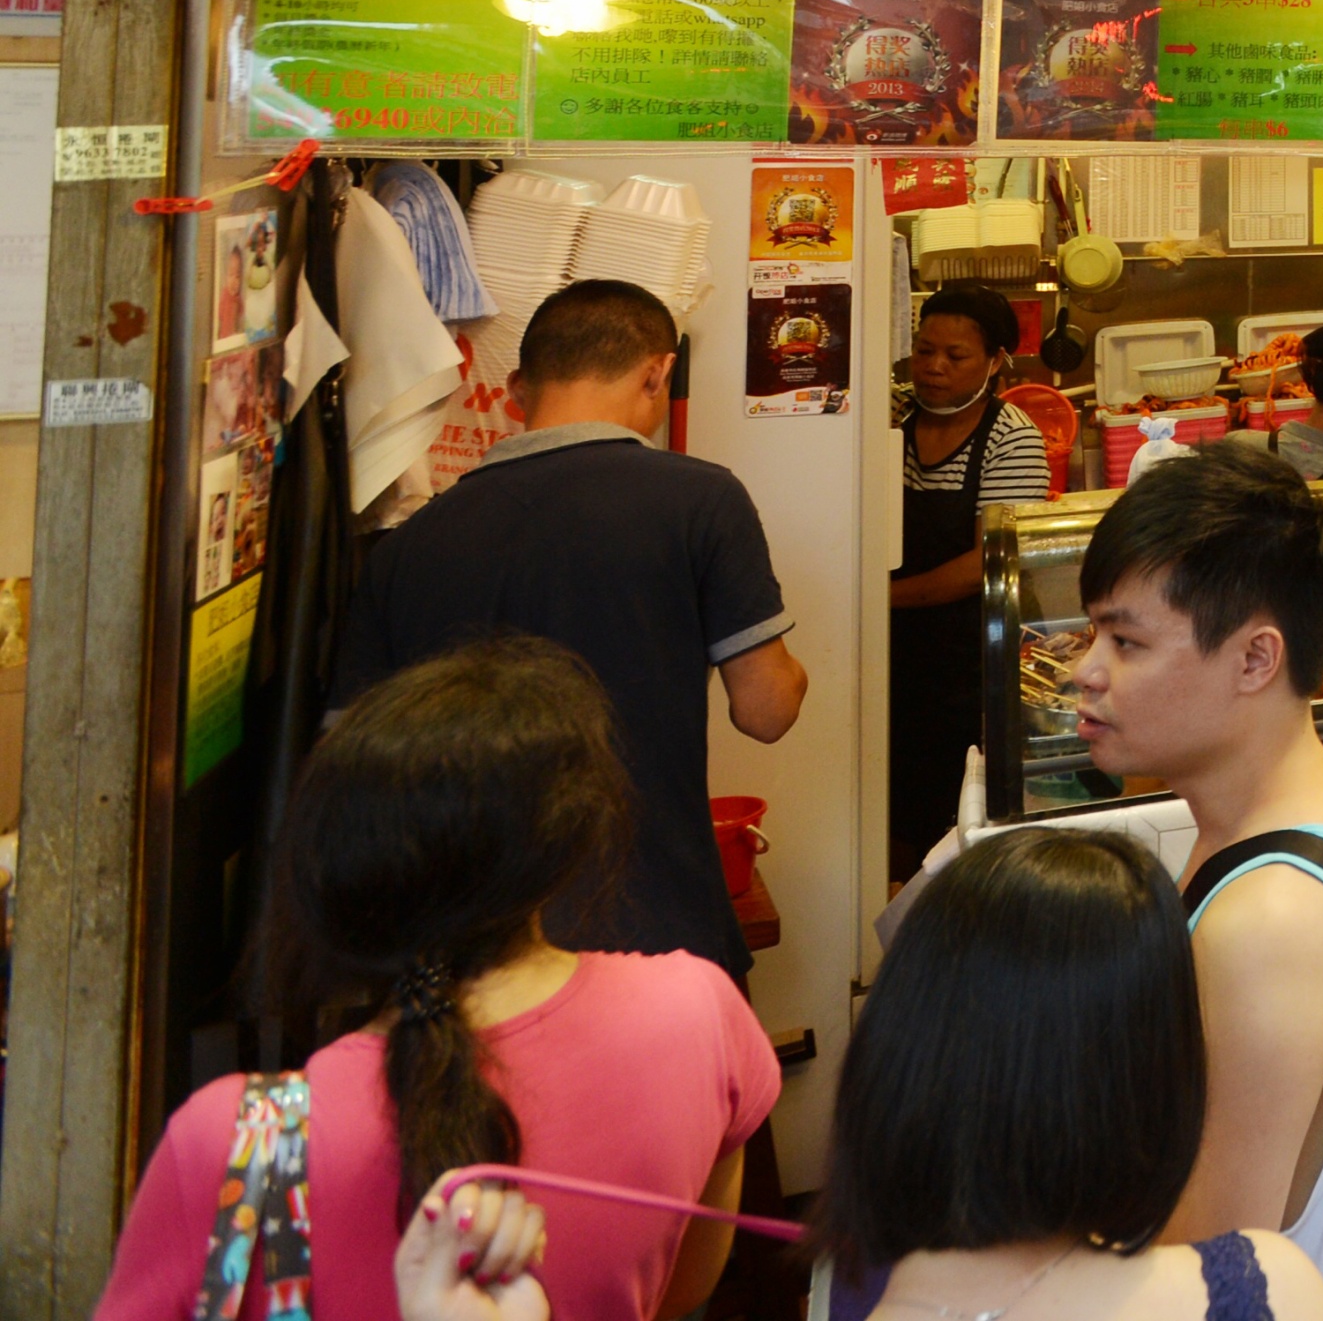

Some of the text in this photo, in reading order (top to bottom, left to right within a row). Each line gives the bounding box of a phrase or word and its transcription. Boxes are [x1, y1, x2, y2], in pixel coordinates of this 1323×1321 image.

[867, 82, 904, 96] 2013
[585, 97, 741, 117] 多謝各位食客支持
[1218, 118, 1290, 140] 每串$6
